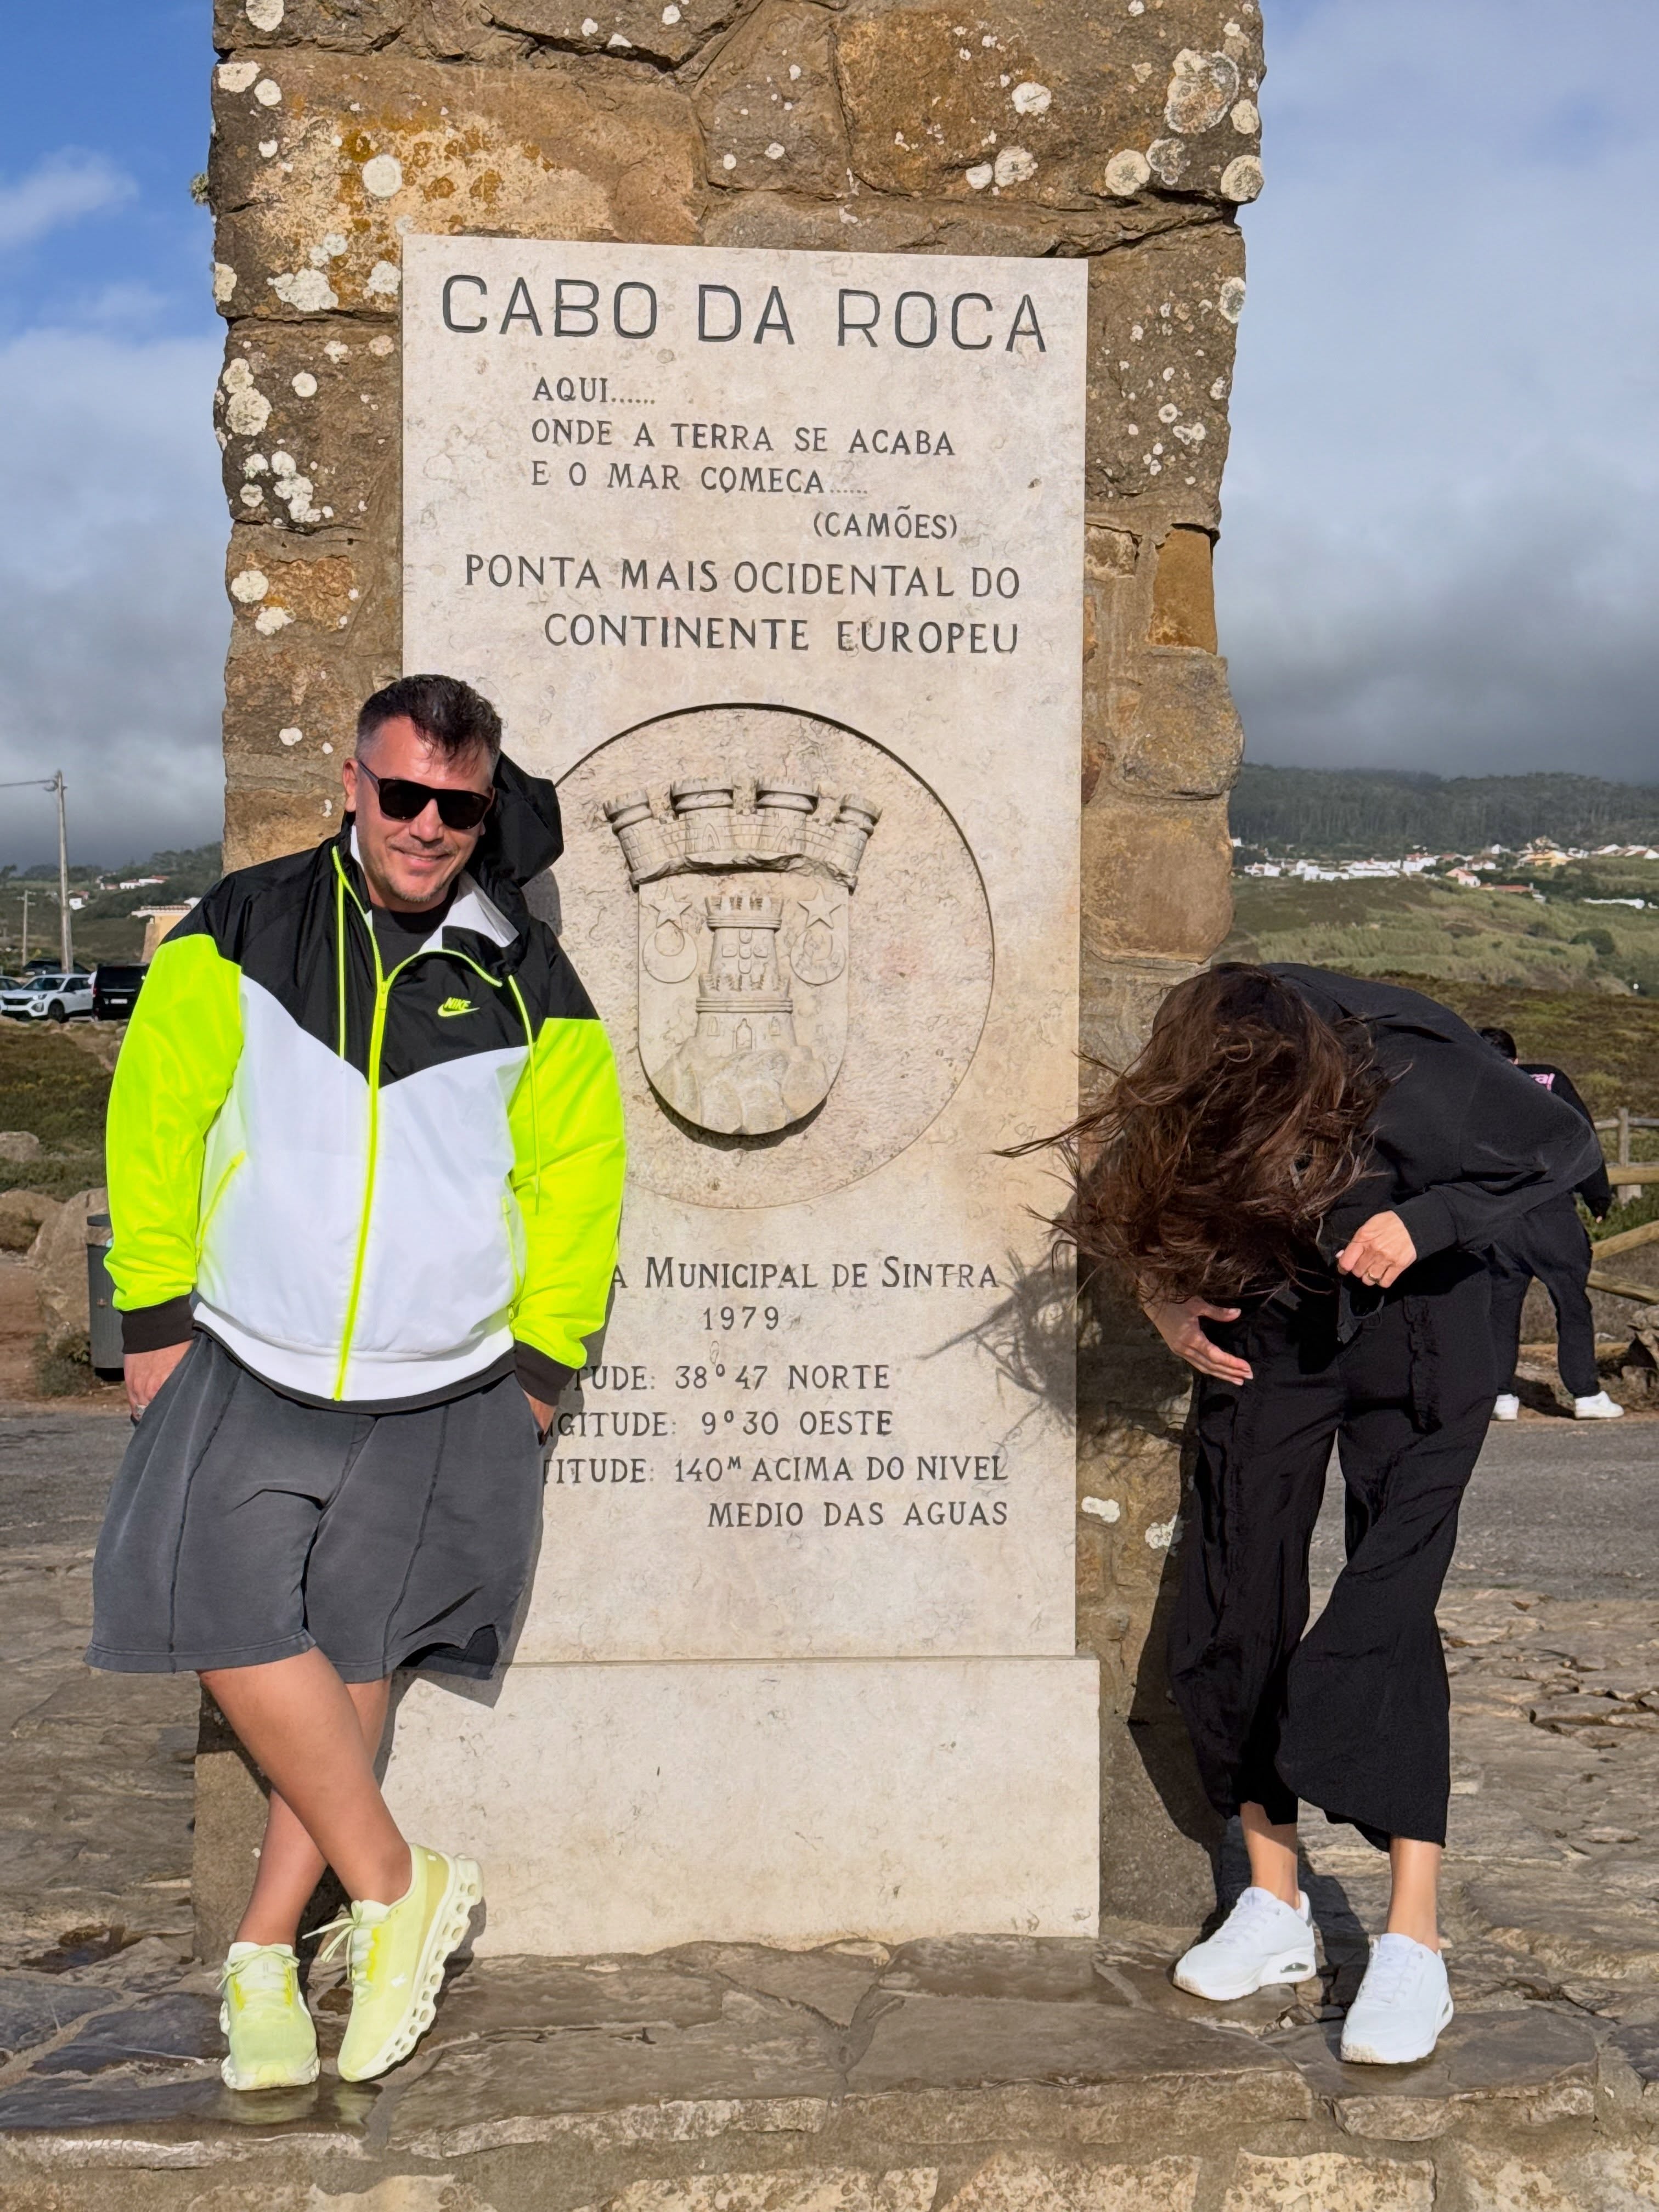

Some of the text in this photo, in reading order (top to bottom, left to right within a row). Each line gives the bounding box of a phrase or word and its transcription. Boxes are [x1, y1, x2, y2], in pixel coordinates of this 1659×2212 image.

[442, 274, 1047, 353] CABO DA ROCA
[531, 419, 956, 456] ONDE A TERRA SE ACABA
[531, 460, 549, 486] E
[568, 461, 586, 486] O
[607, 462, 680, 490] MAR
[813, 504, 958, 540] (CAMÕES)
[465, 554, 1020, 599] PONTA MAIS OCIDENTAL DO
[544, 613, 1019, 655] CONTINENTE EUROPEU
[443, 997, 471, 1010] NIKE
[644, 1256, 819, 1289] MUNICIPAL
[832, 1263, 868, 1289] DE
[881, 1256, 1001, 1289] SINTRA
[703, 1306, 780, 1331] 1979
[562, 1365, 656, 1391] TUDE:
[787, 1365, 890, 1390] NORTE
[799, 1410, 894, 1436] OESTE
[750, 1457, 854, 1482] ACIMA
[866, 1457, 905, 1481] DO
[916, 1456, 1009, 1481] NIVEL
[707, 1502, 1008, 1528] MEDIO DAS AGUAS
